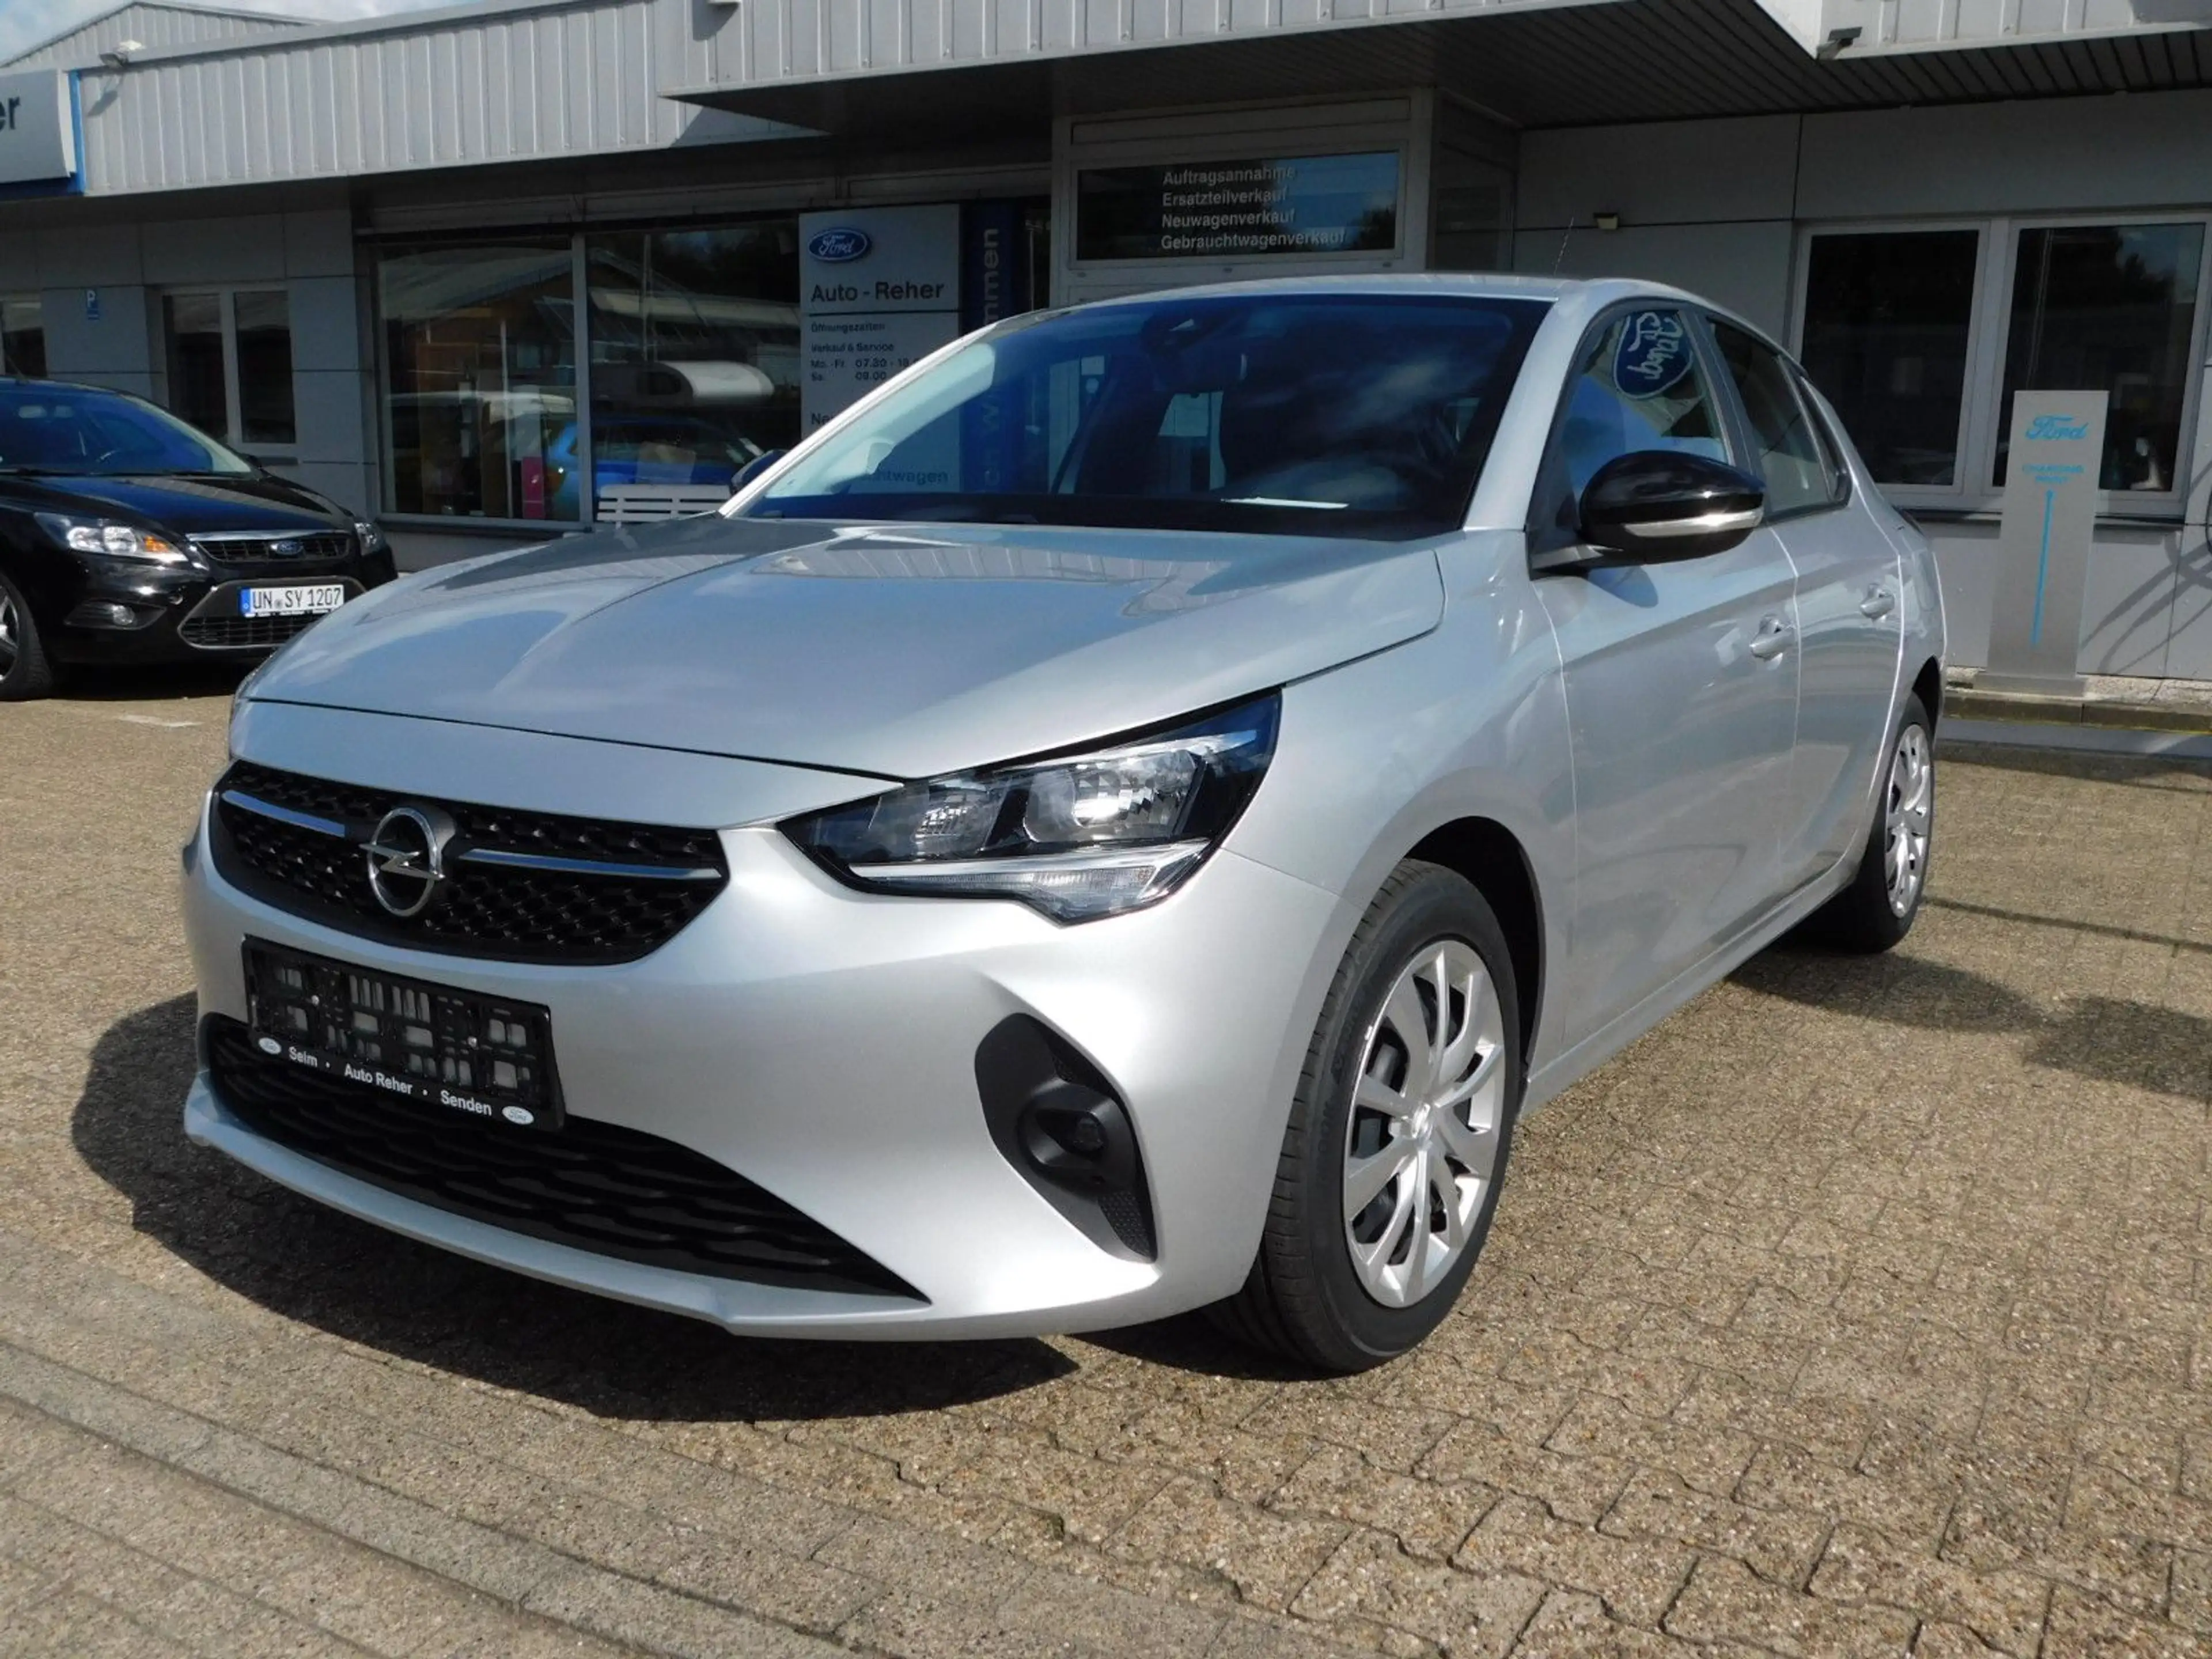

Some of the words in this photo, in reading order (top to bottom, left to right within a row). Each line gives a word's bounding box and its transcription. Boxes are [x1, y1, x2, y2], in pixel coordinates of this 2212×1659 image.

[1163, 166, 1296, 186] Auftragsannahme
[1162, 187, 1287, 207] Ersatzteilverkauf
[1162, 208, 1296, 230] Neuwagenverkauf
[818, 233, 855, 256] Ford
[1161, 228, 1346, 251] Gebrauchtwagenverkauf
[811, 284, 858, 302] Auto
[874, 281, 945, 300] Reher
[2025, 415, 2089, 441] Ford
[252, 590, 272, 609] UN
[285, 589, 302, 608] SY
[307, 587, 341, 607] 1207
[344, 1063, 373, 1085] Auto
[376, 1071, 414, 1095] Reher
[440, 1089, 493, 1117] Senden
